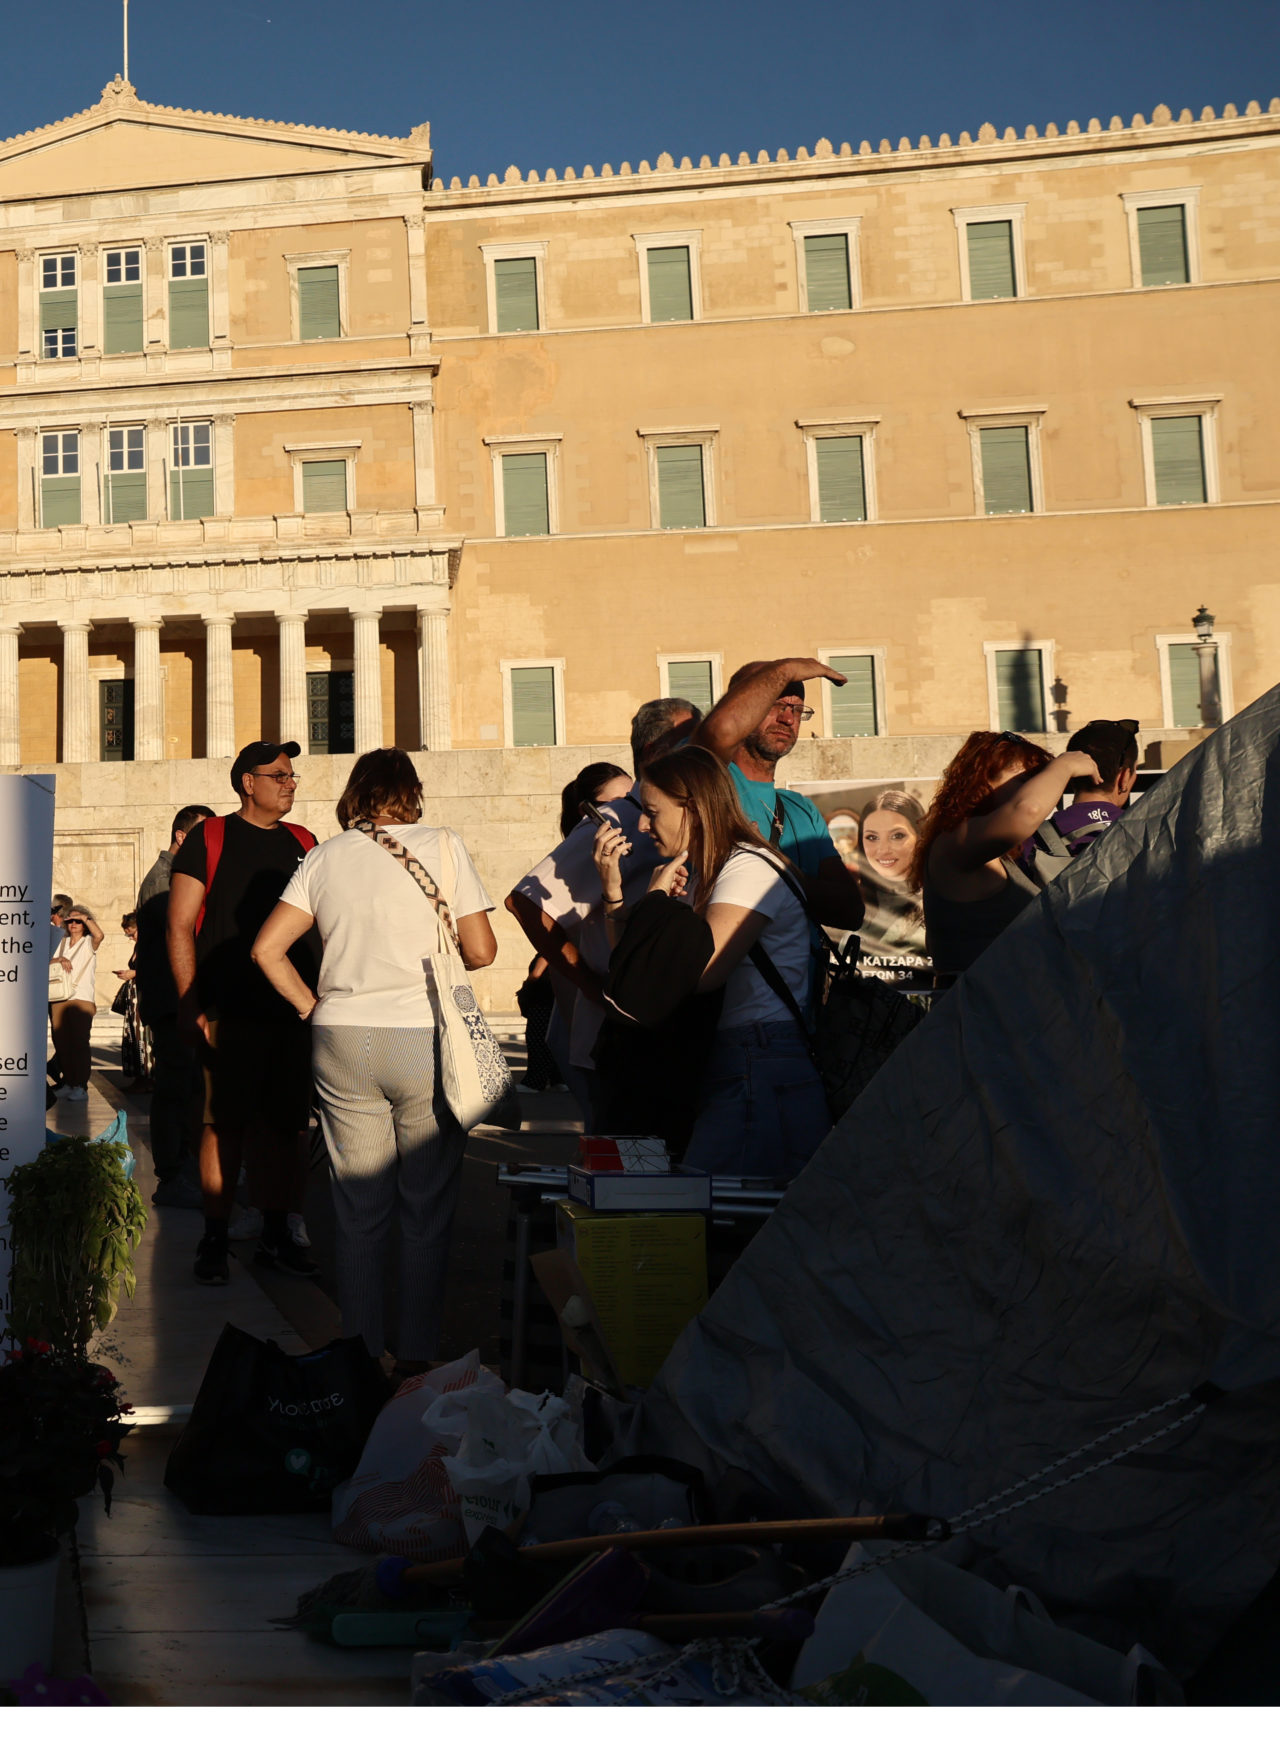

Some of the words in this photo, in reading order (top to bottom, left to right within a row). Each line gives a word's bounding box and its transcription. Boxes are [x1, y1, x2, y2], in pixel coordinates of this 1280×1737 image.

[0, 884, 29, 903] my
[1, 937, 33, 953] the
[863, 956, 924, 967] ΚΑΤΣΑΡΑ
[898, 971, 914, 980] 34
